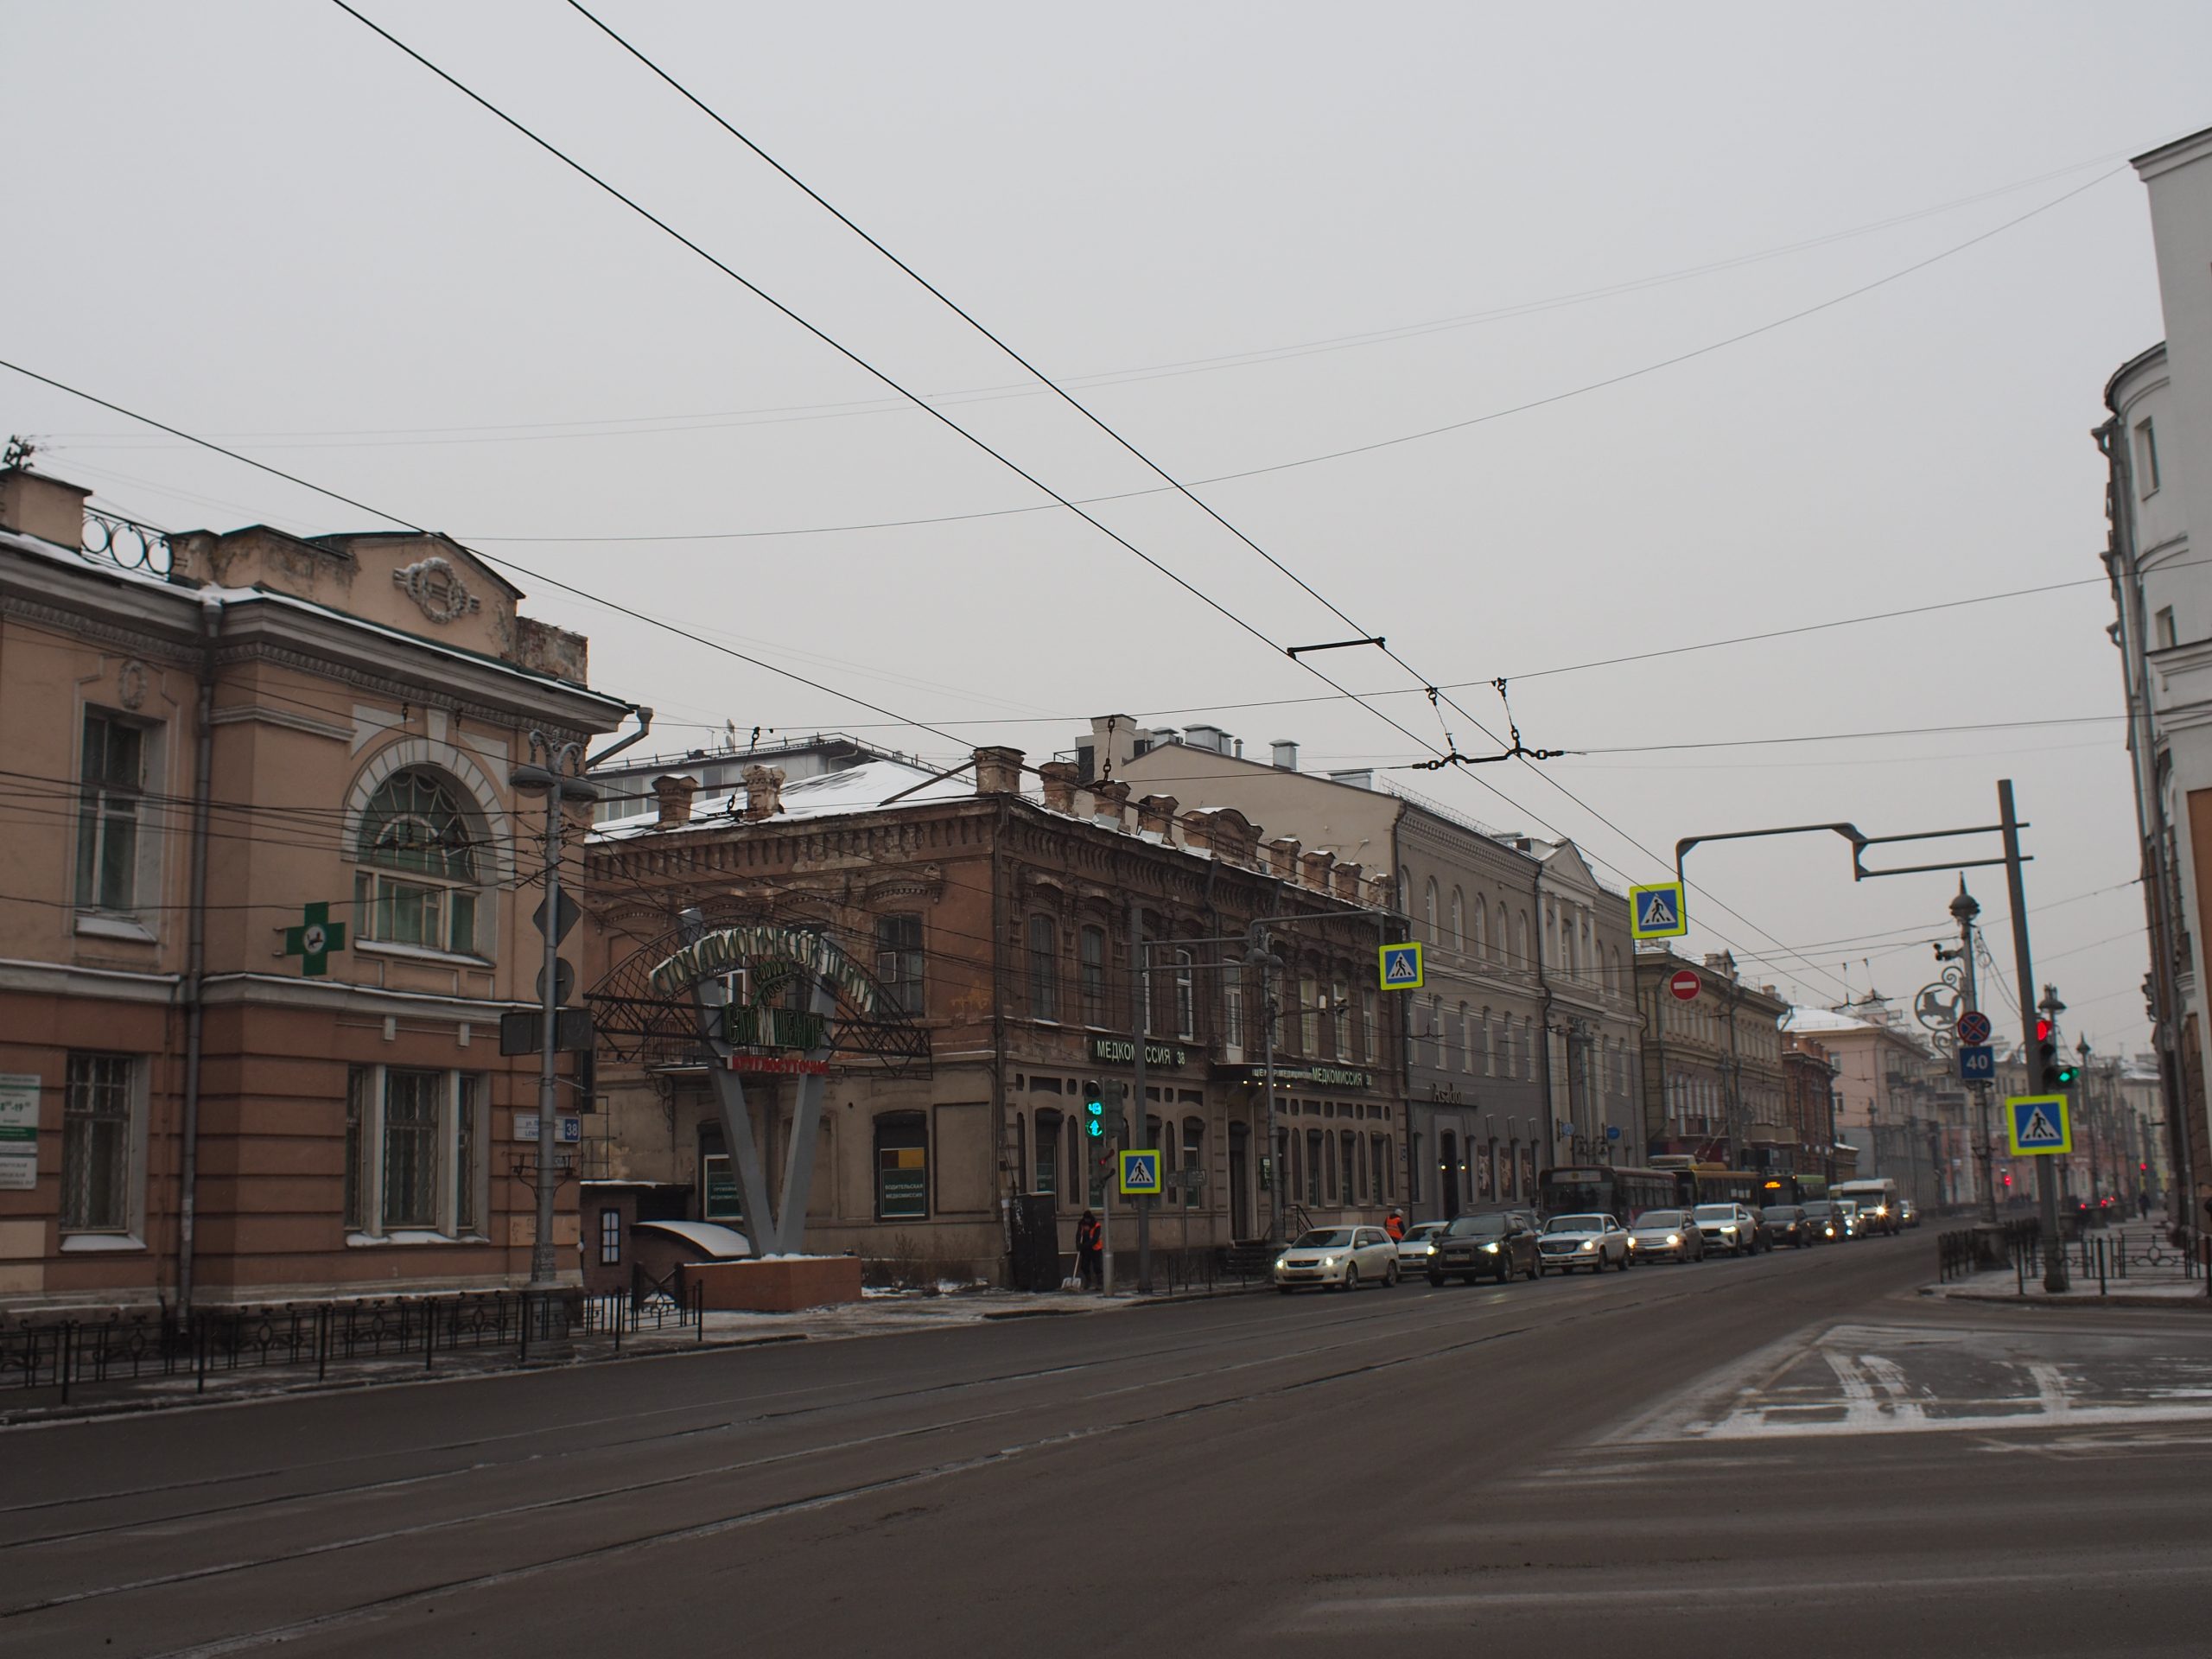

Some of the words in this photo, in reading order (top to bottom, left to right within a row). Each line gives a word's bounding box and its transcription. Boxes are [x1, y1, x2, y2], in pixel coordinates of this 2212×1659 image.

[649, 925, 821, 995] СТОМАТОЛОГИЧЕСКИЙ
[1096, 1039, 1172, 1065] МЕДКОССИЯ
[1177, 1051, 1185, 1065] 38
[1966, 1054, 1989, 1071] 40
[1312, 1066, 1363, 1087] МЕДКОМИССИЯ
[566, 1122, 578, 1136] 38
